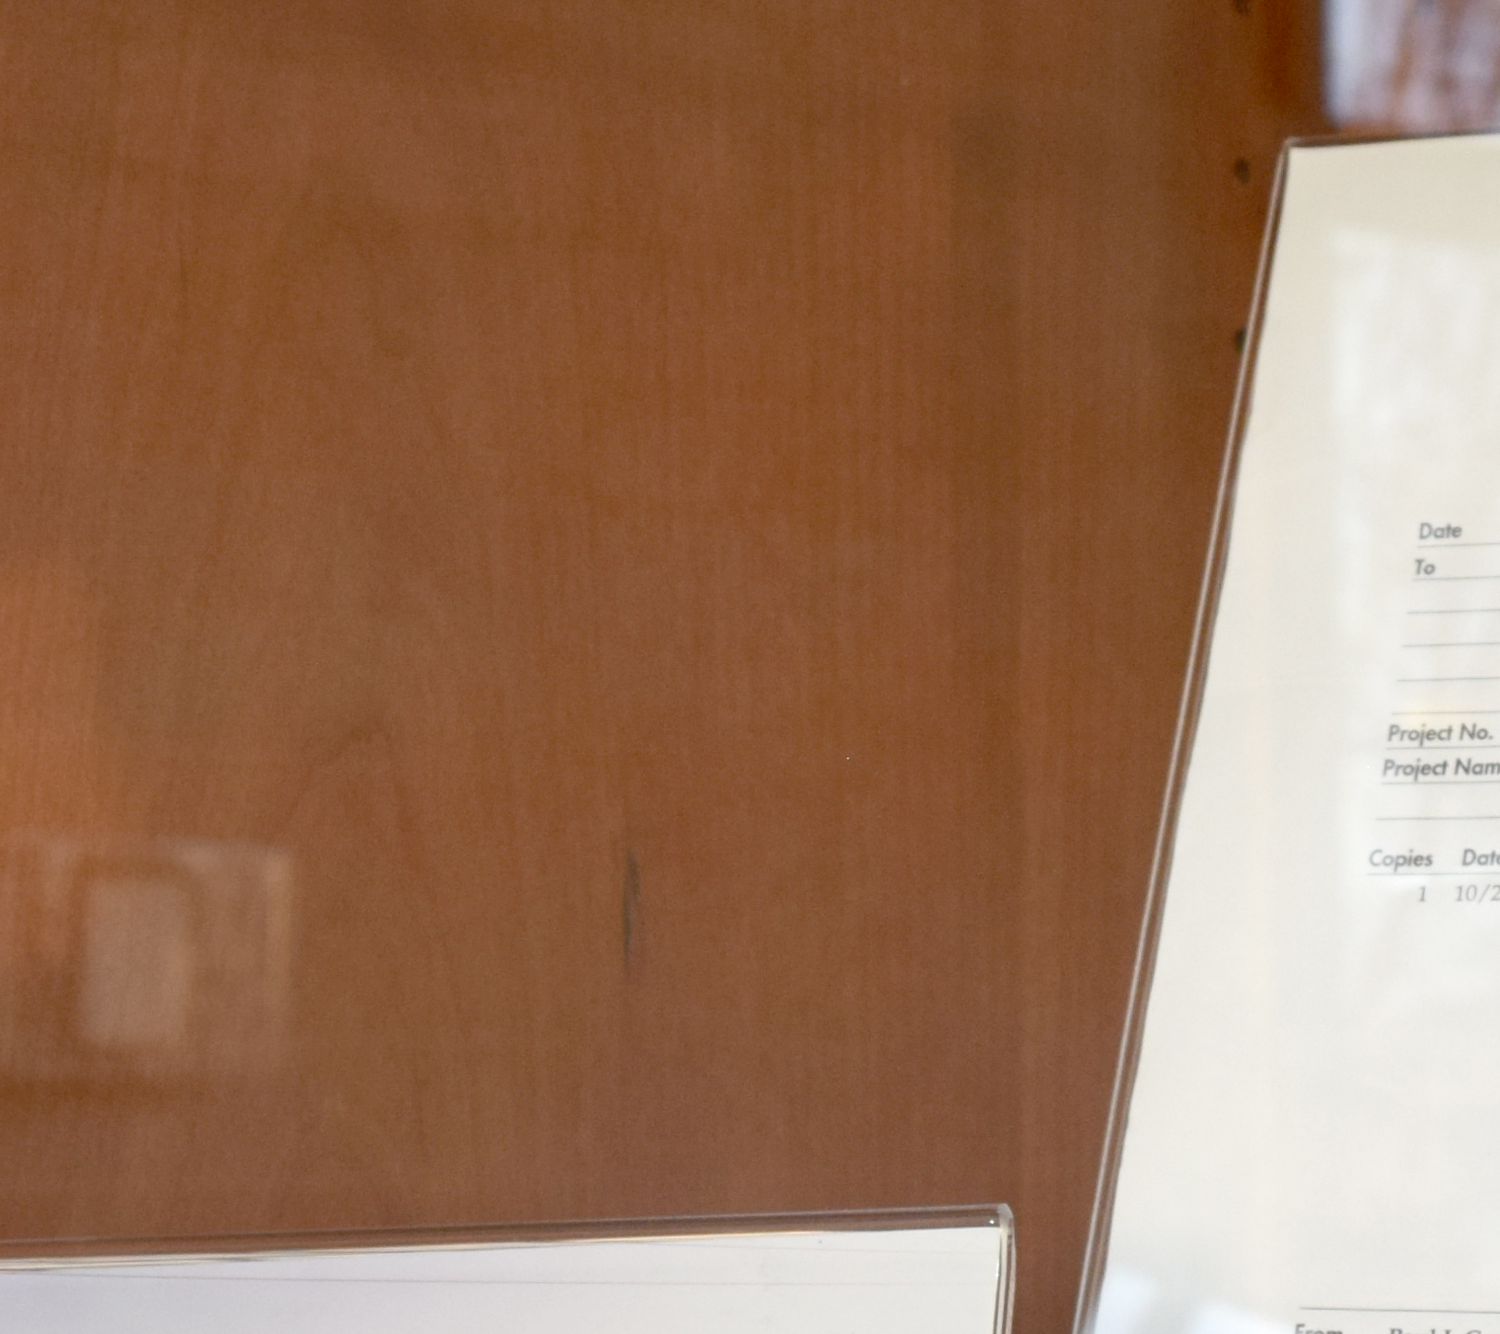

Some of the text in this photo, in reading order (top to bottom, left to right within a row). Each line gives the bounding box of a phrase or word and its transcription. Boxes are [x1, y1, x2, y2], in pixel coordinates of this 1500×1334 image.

[1418, 521, 1463, 540] Date
[1413, 558, 1436, 577] To
[1387, 723, 1495, 747] Project No.
[1382, 758, 1448, 780] Project
[1369, 848, 1434, 872] Copies
[1416, 884, 1428, 903] 1
